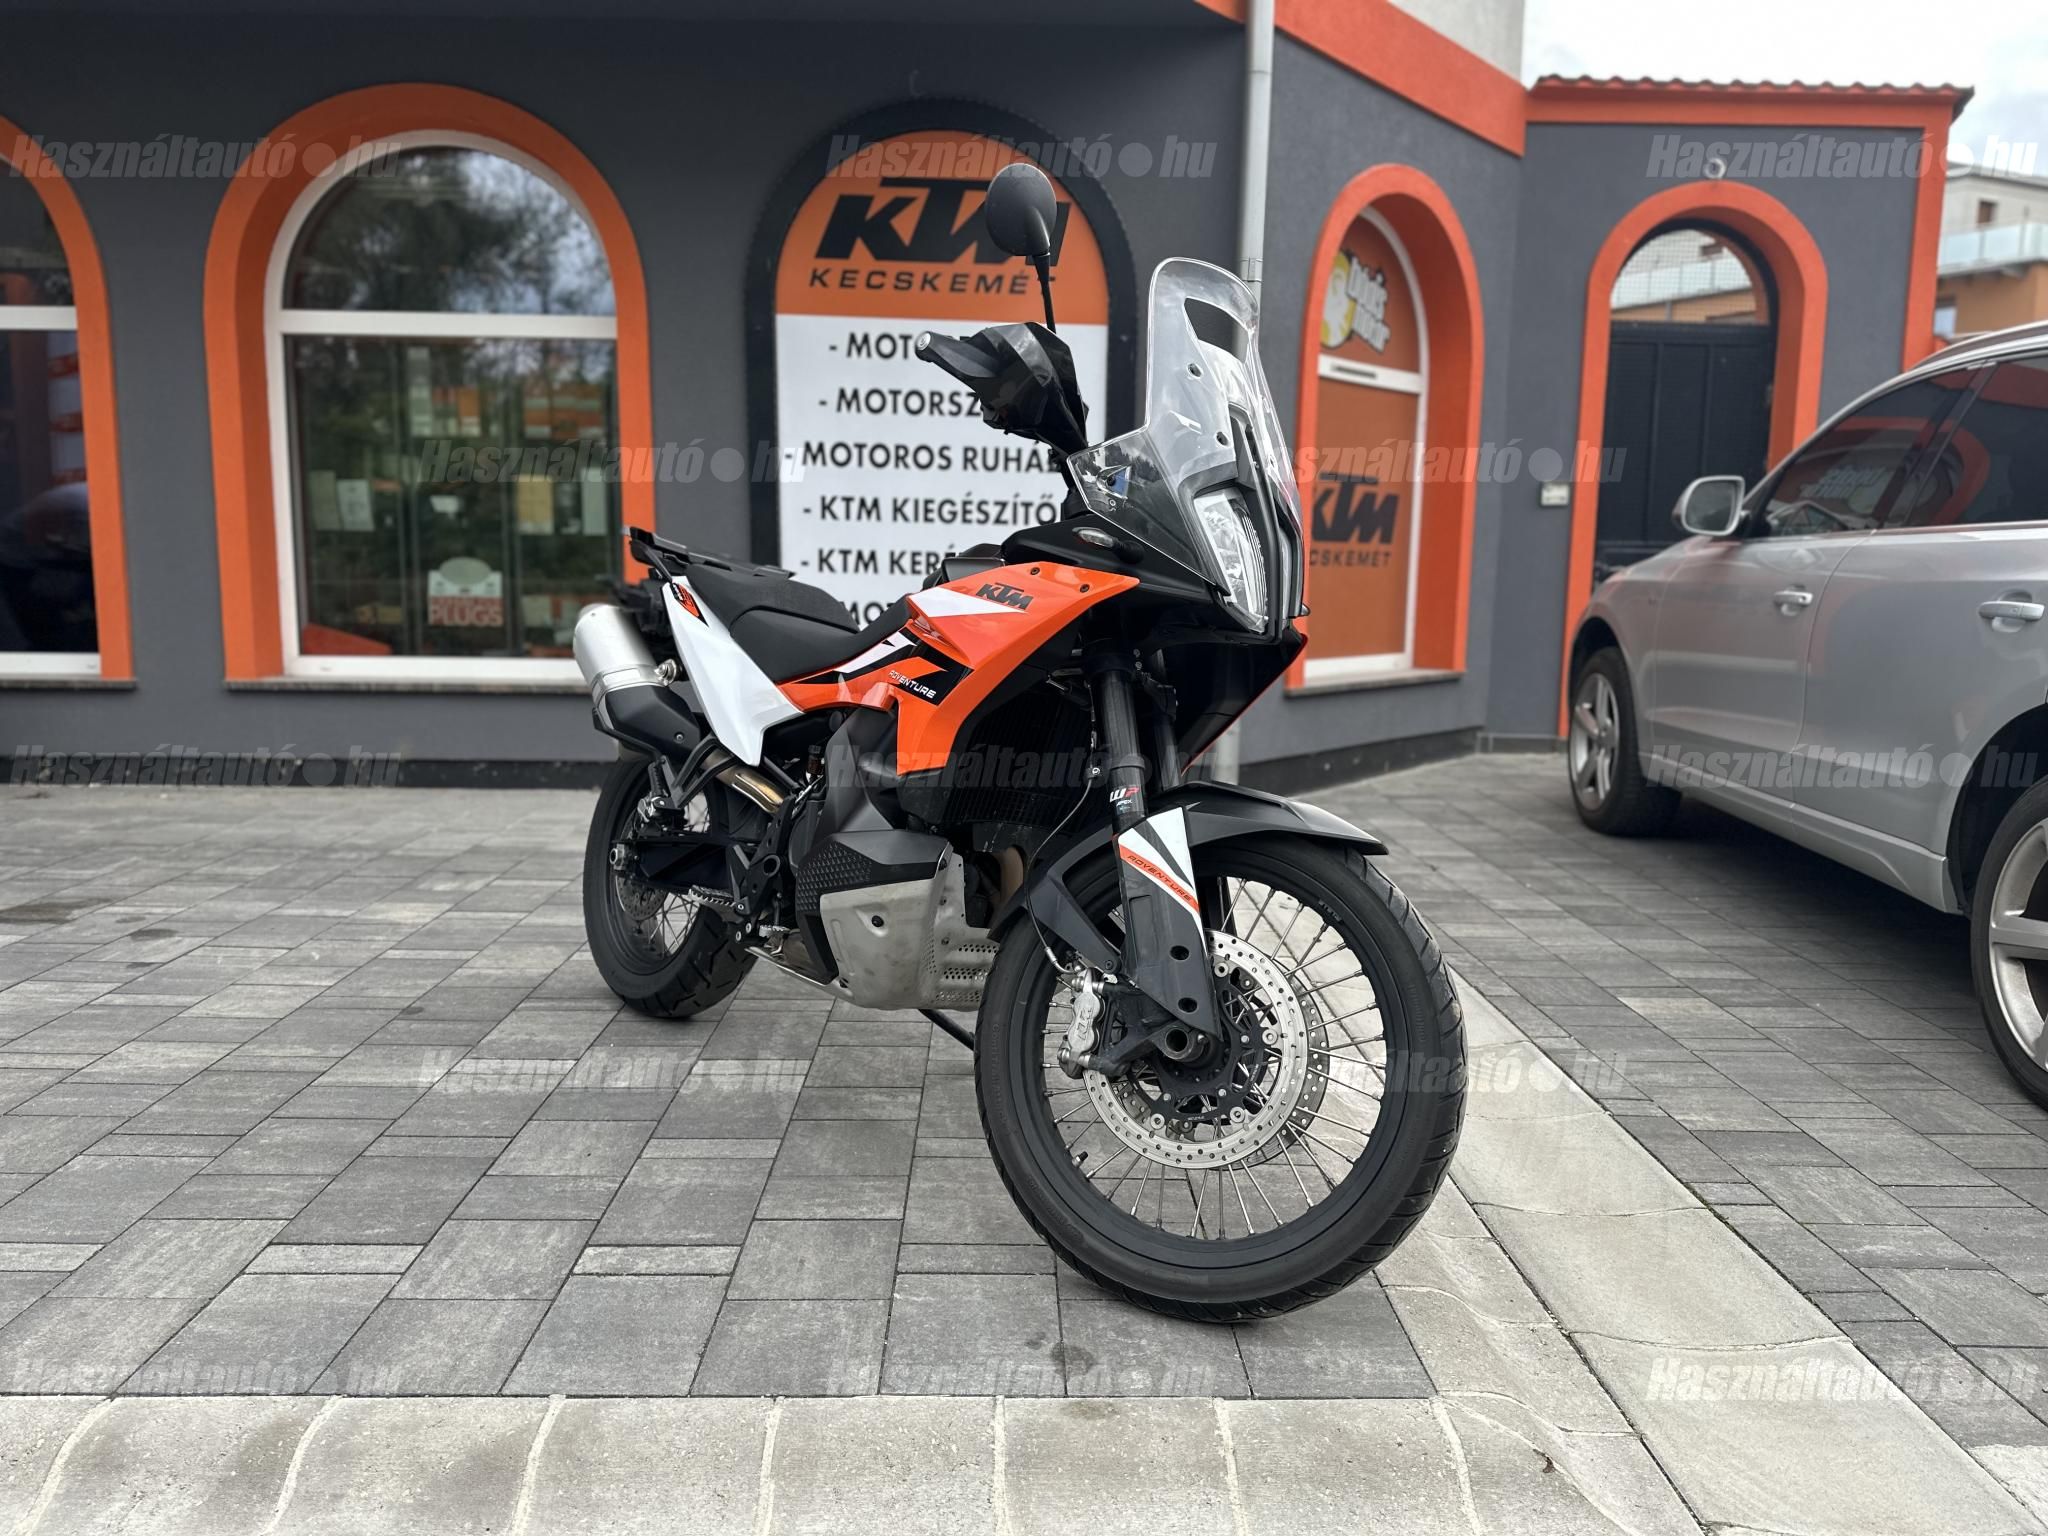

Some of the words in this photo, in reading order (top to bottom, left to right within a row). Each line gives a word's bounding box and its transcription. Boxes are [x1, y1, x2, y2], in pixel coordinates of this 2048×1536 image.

[808, 269, 1056, 295] KECSKEMÉ
[836, 387, 983, 417] MOTORSZ
[802, 441, 951, 470] MOTOROS
[962, 440, 1061, 473] RUHÁ
[820, 495, 881, 522] KTM
[892, 491, 1057, 525] KIEGÉSZÍTŐ
[817, 548, 879, 574] KTM
[976, 582, 1034, 611] KTM
[888, 669, 937, 699] ADVENTURE
[1110, 787, 1140, 803] WP
[1127, 855, 1191, 901] ADVENTURE
